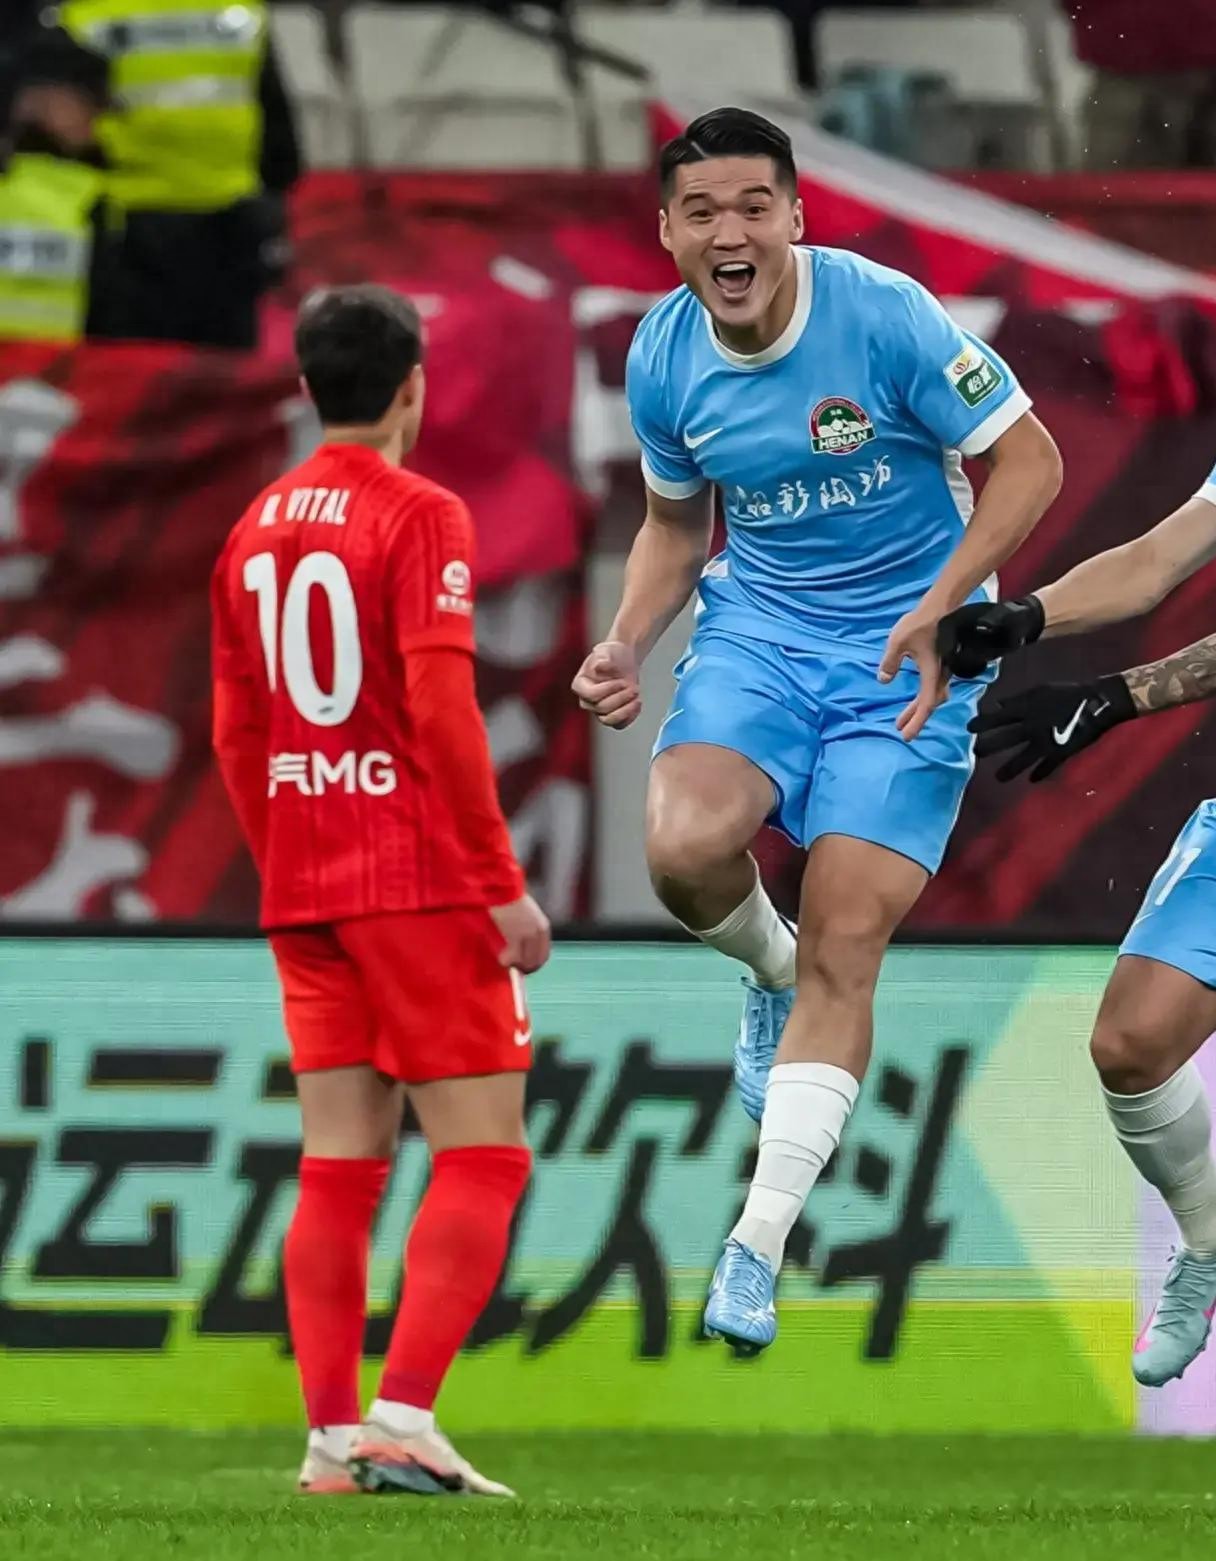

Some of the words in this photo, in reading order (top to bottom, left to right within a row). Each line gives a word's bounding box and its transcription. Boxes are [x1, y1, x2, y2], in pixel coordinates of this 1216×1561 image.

[818, 430, 868, 450] HENAN
[285, 487, 350, 525] VITAL
[243, 550, 363, 727] 10
